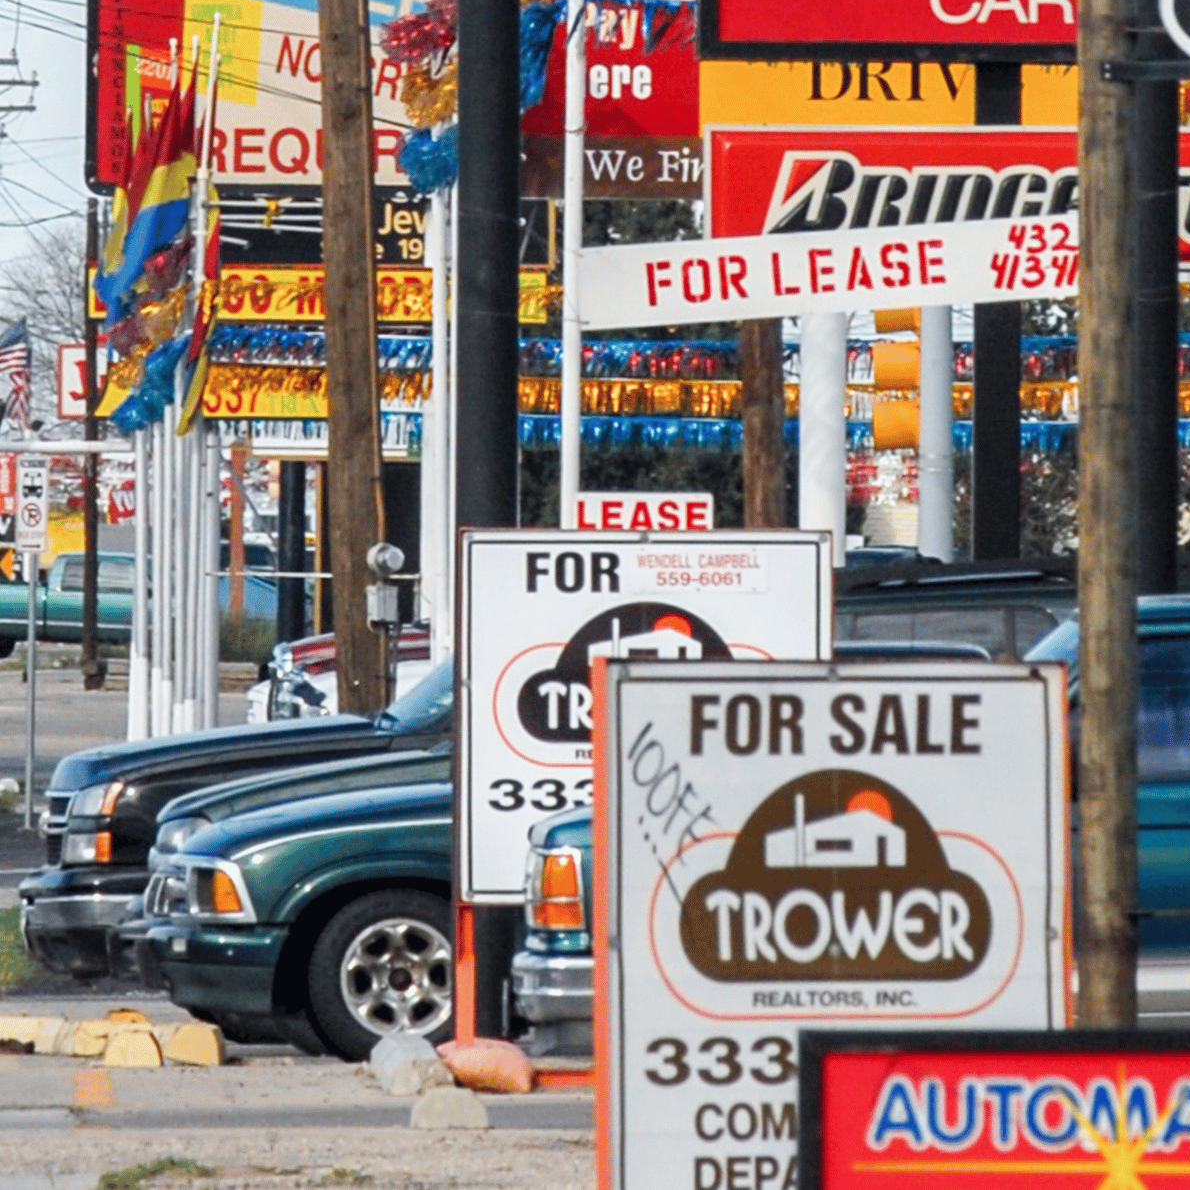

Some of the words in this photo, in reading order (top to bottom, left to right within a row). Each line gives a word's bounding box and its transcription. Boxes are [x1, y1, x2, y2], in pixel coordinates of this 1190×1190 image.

[584, 148, 645, 185] We
[1007, 221, 1080, 255] 432
[644, 255, 749, 307] FOR
[771, 238, 947, 297] LEASE
[576, 500, 710, 532] LEASE
[525, 551, 621, 594] FOR
[656, 571, 743, 587] 559-6061
[689, 693, 806, 757] FOR
[828, 693, 983, 757] SALE
[705, 887, 975, 964] TROWER
[875, 990, 918, 1008] INC.
